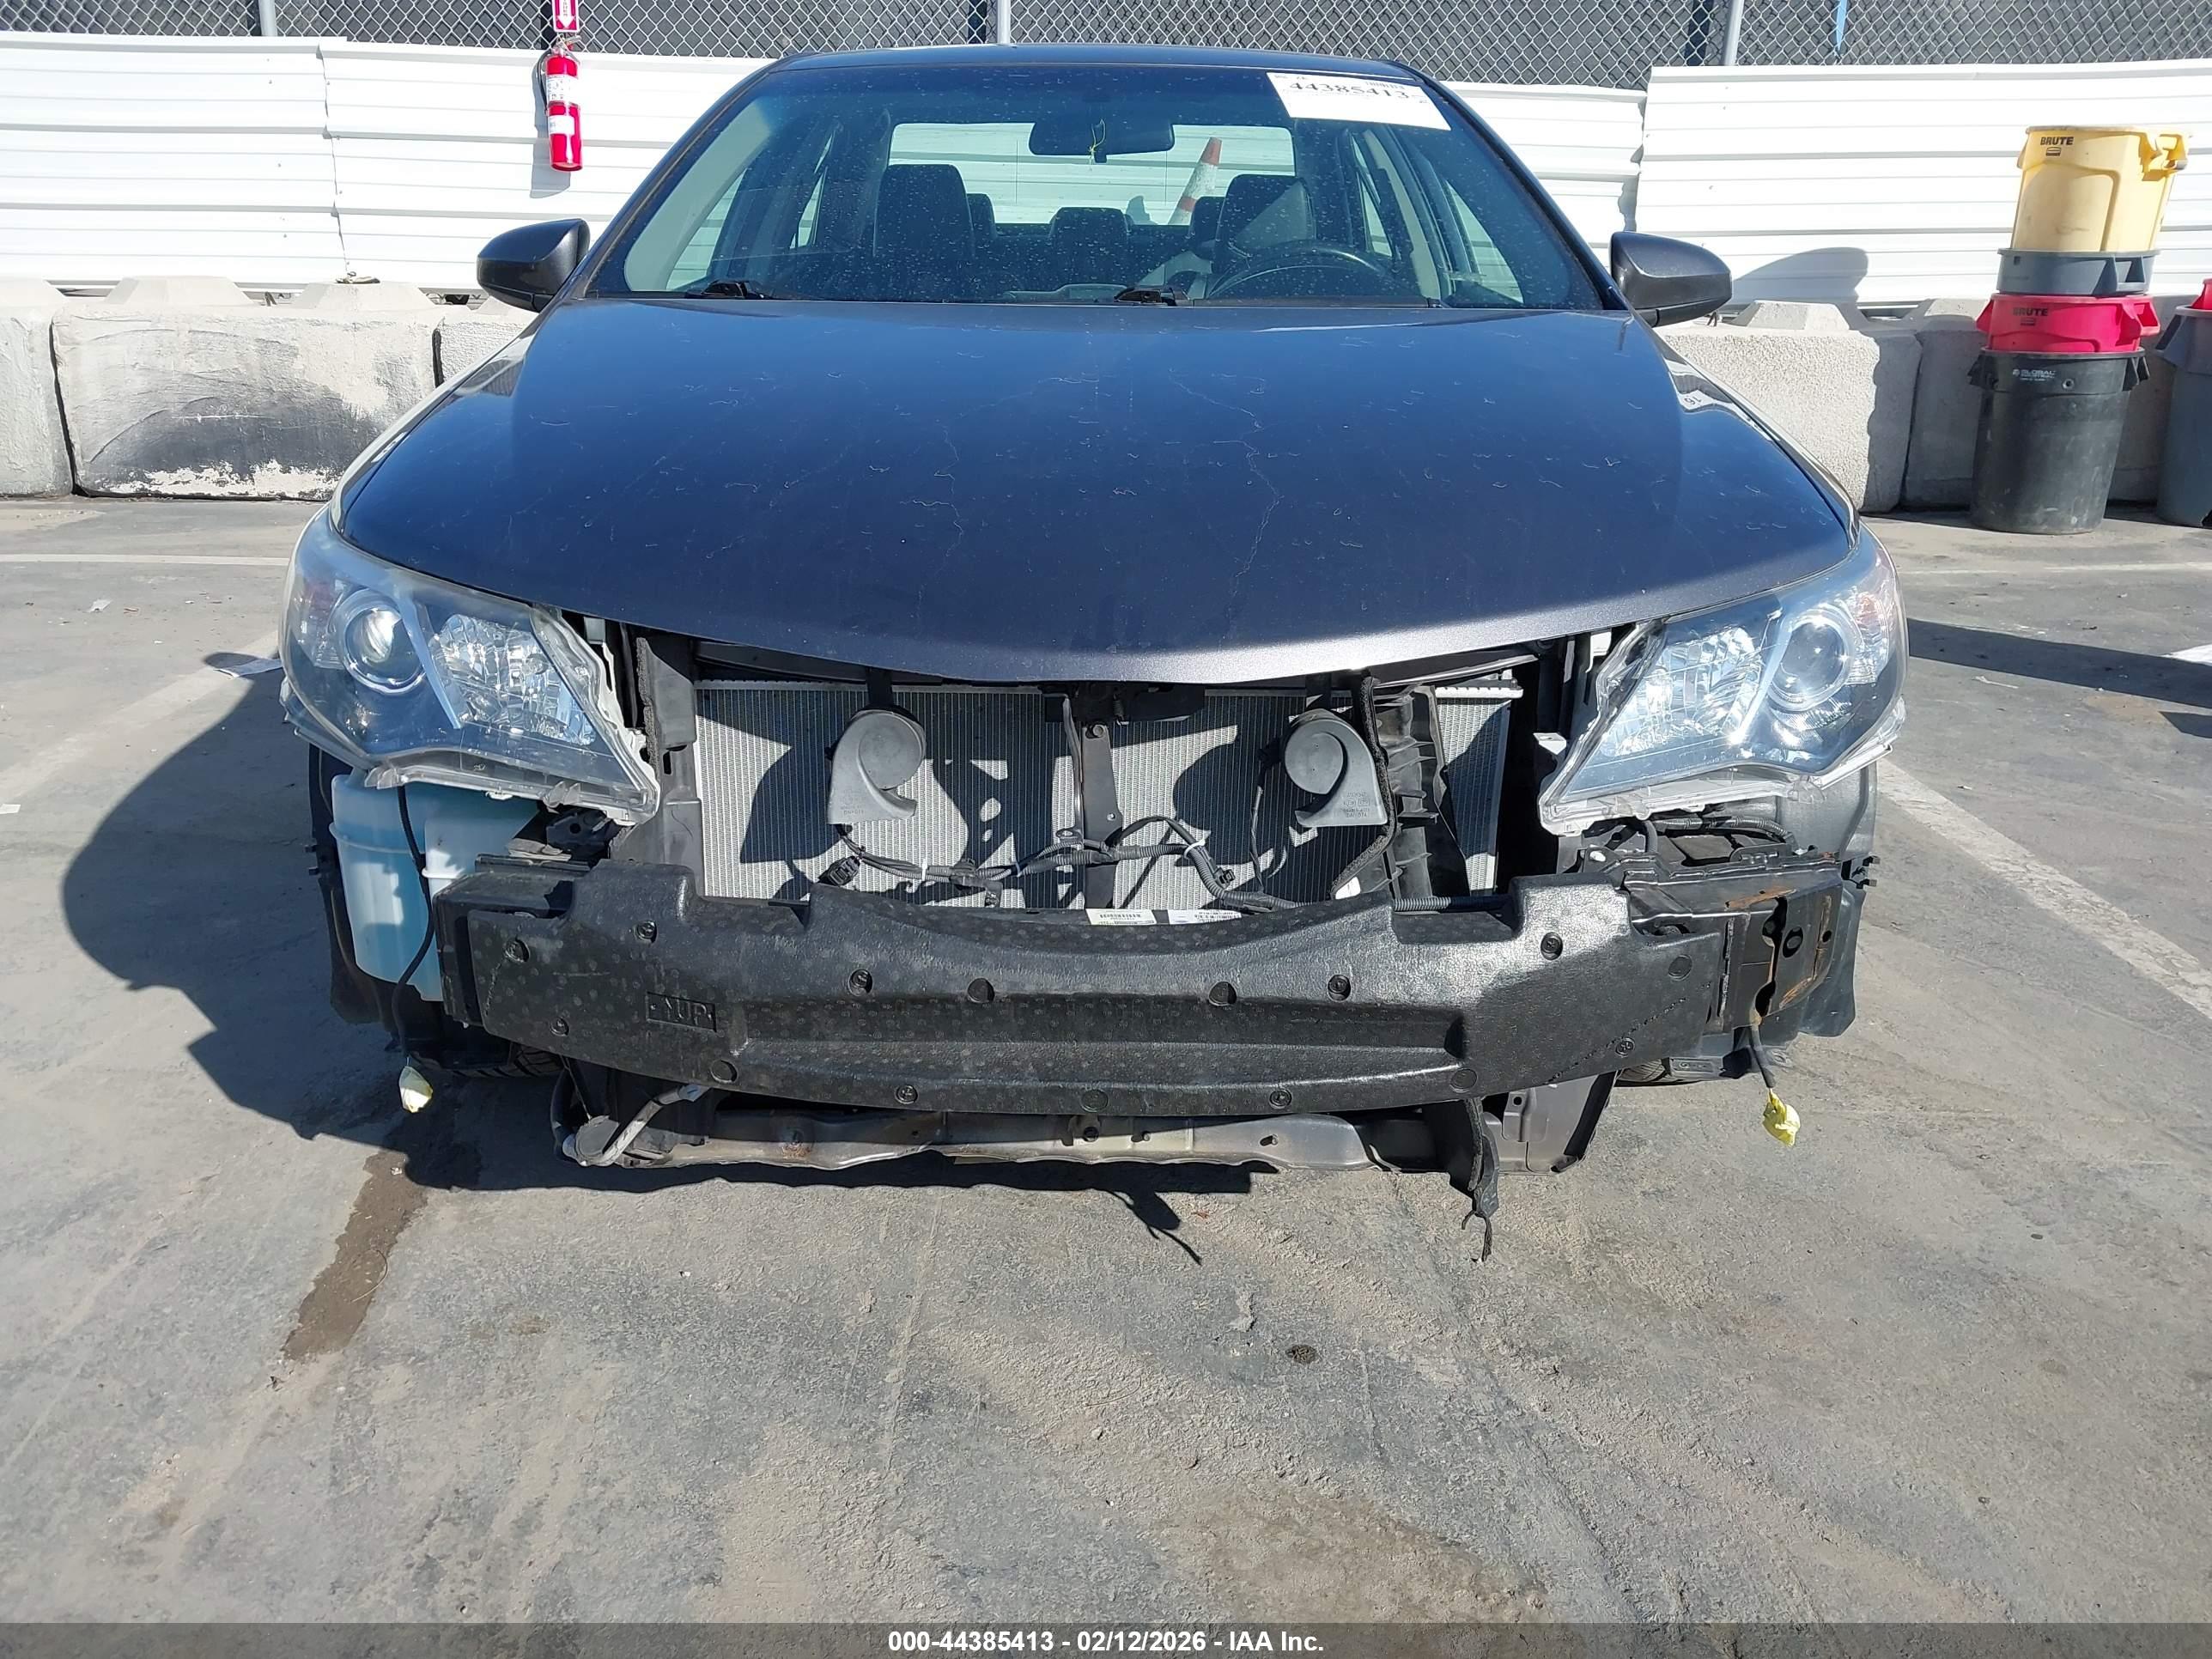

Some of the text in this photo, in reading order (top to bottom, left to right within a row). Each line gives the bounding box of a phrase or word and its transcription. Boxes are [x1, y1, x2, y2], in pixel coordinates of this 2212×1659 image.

[1289, 82, 1410, 99] 44385413
[2040, 136, 2074, 146] BRUTE
[2013, 307, 2049, 317] BRUTE
